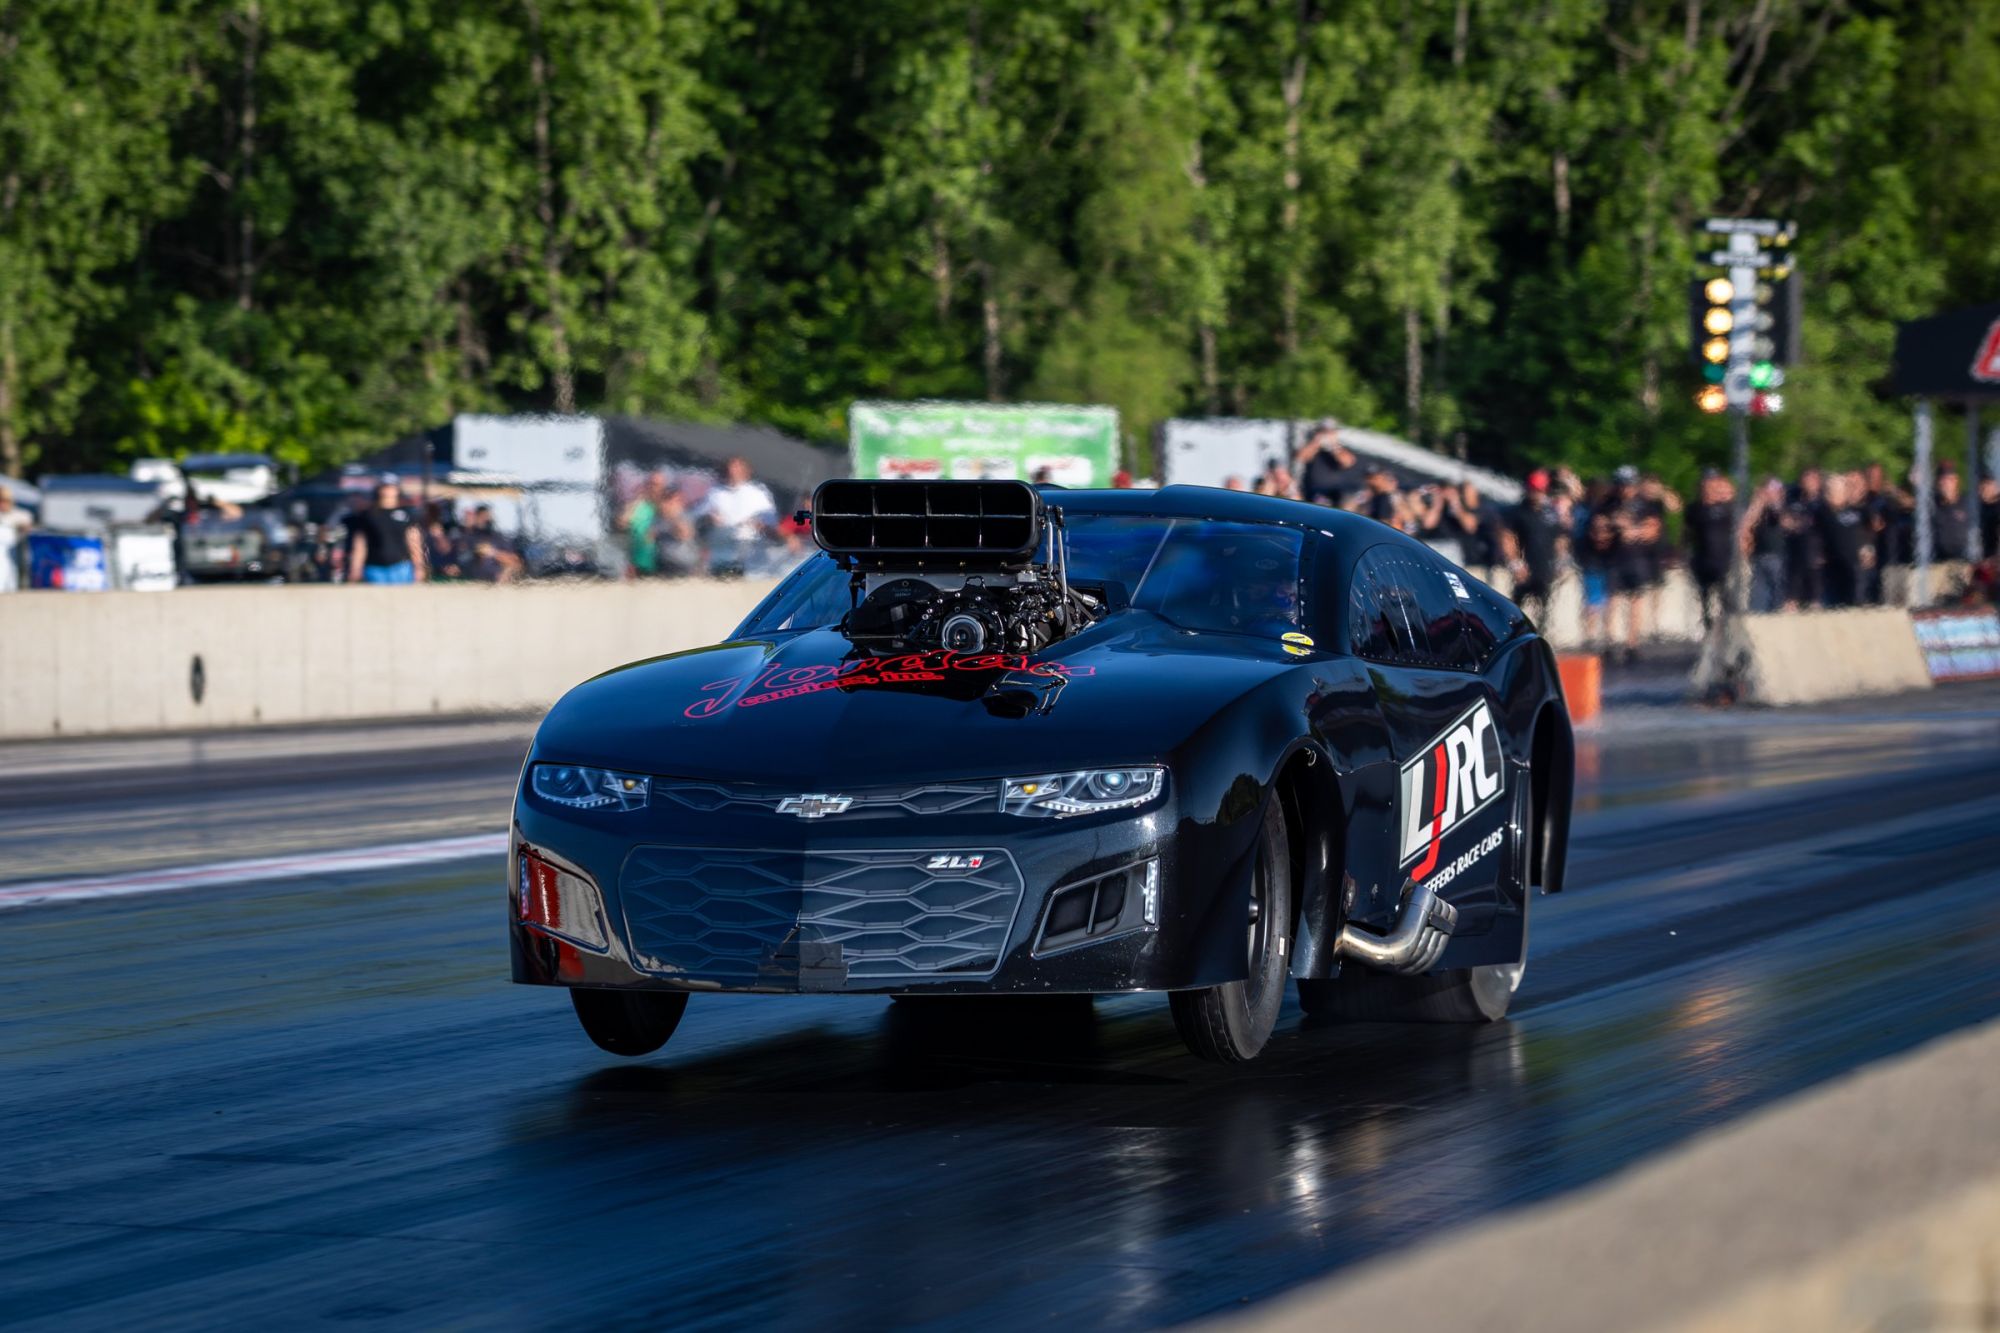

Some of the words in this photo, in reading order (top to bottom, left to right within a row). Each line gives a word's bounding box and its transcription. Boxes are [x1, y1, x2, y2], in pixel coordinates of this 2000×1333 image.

[926, 854, 984, 869] ZL1
[1456, 844, 1480, 875] RACE
[1481, 827, 1503, 857] CARS
